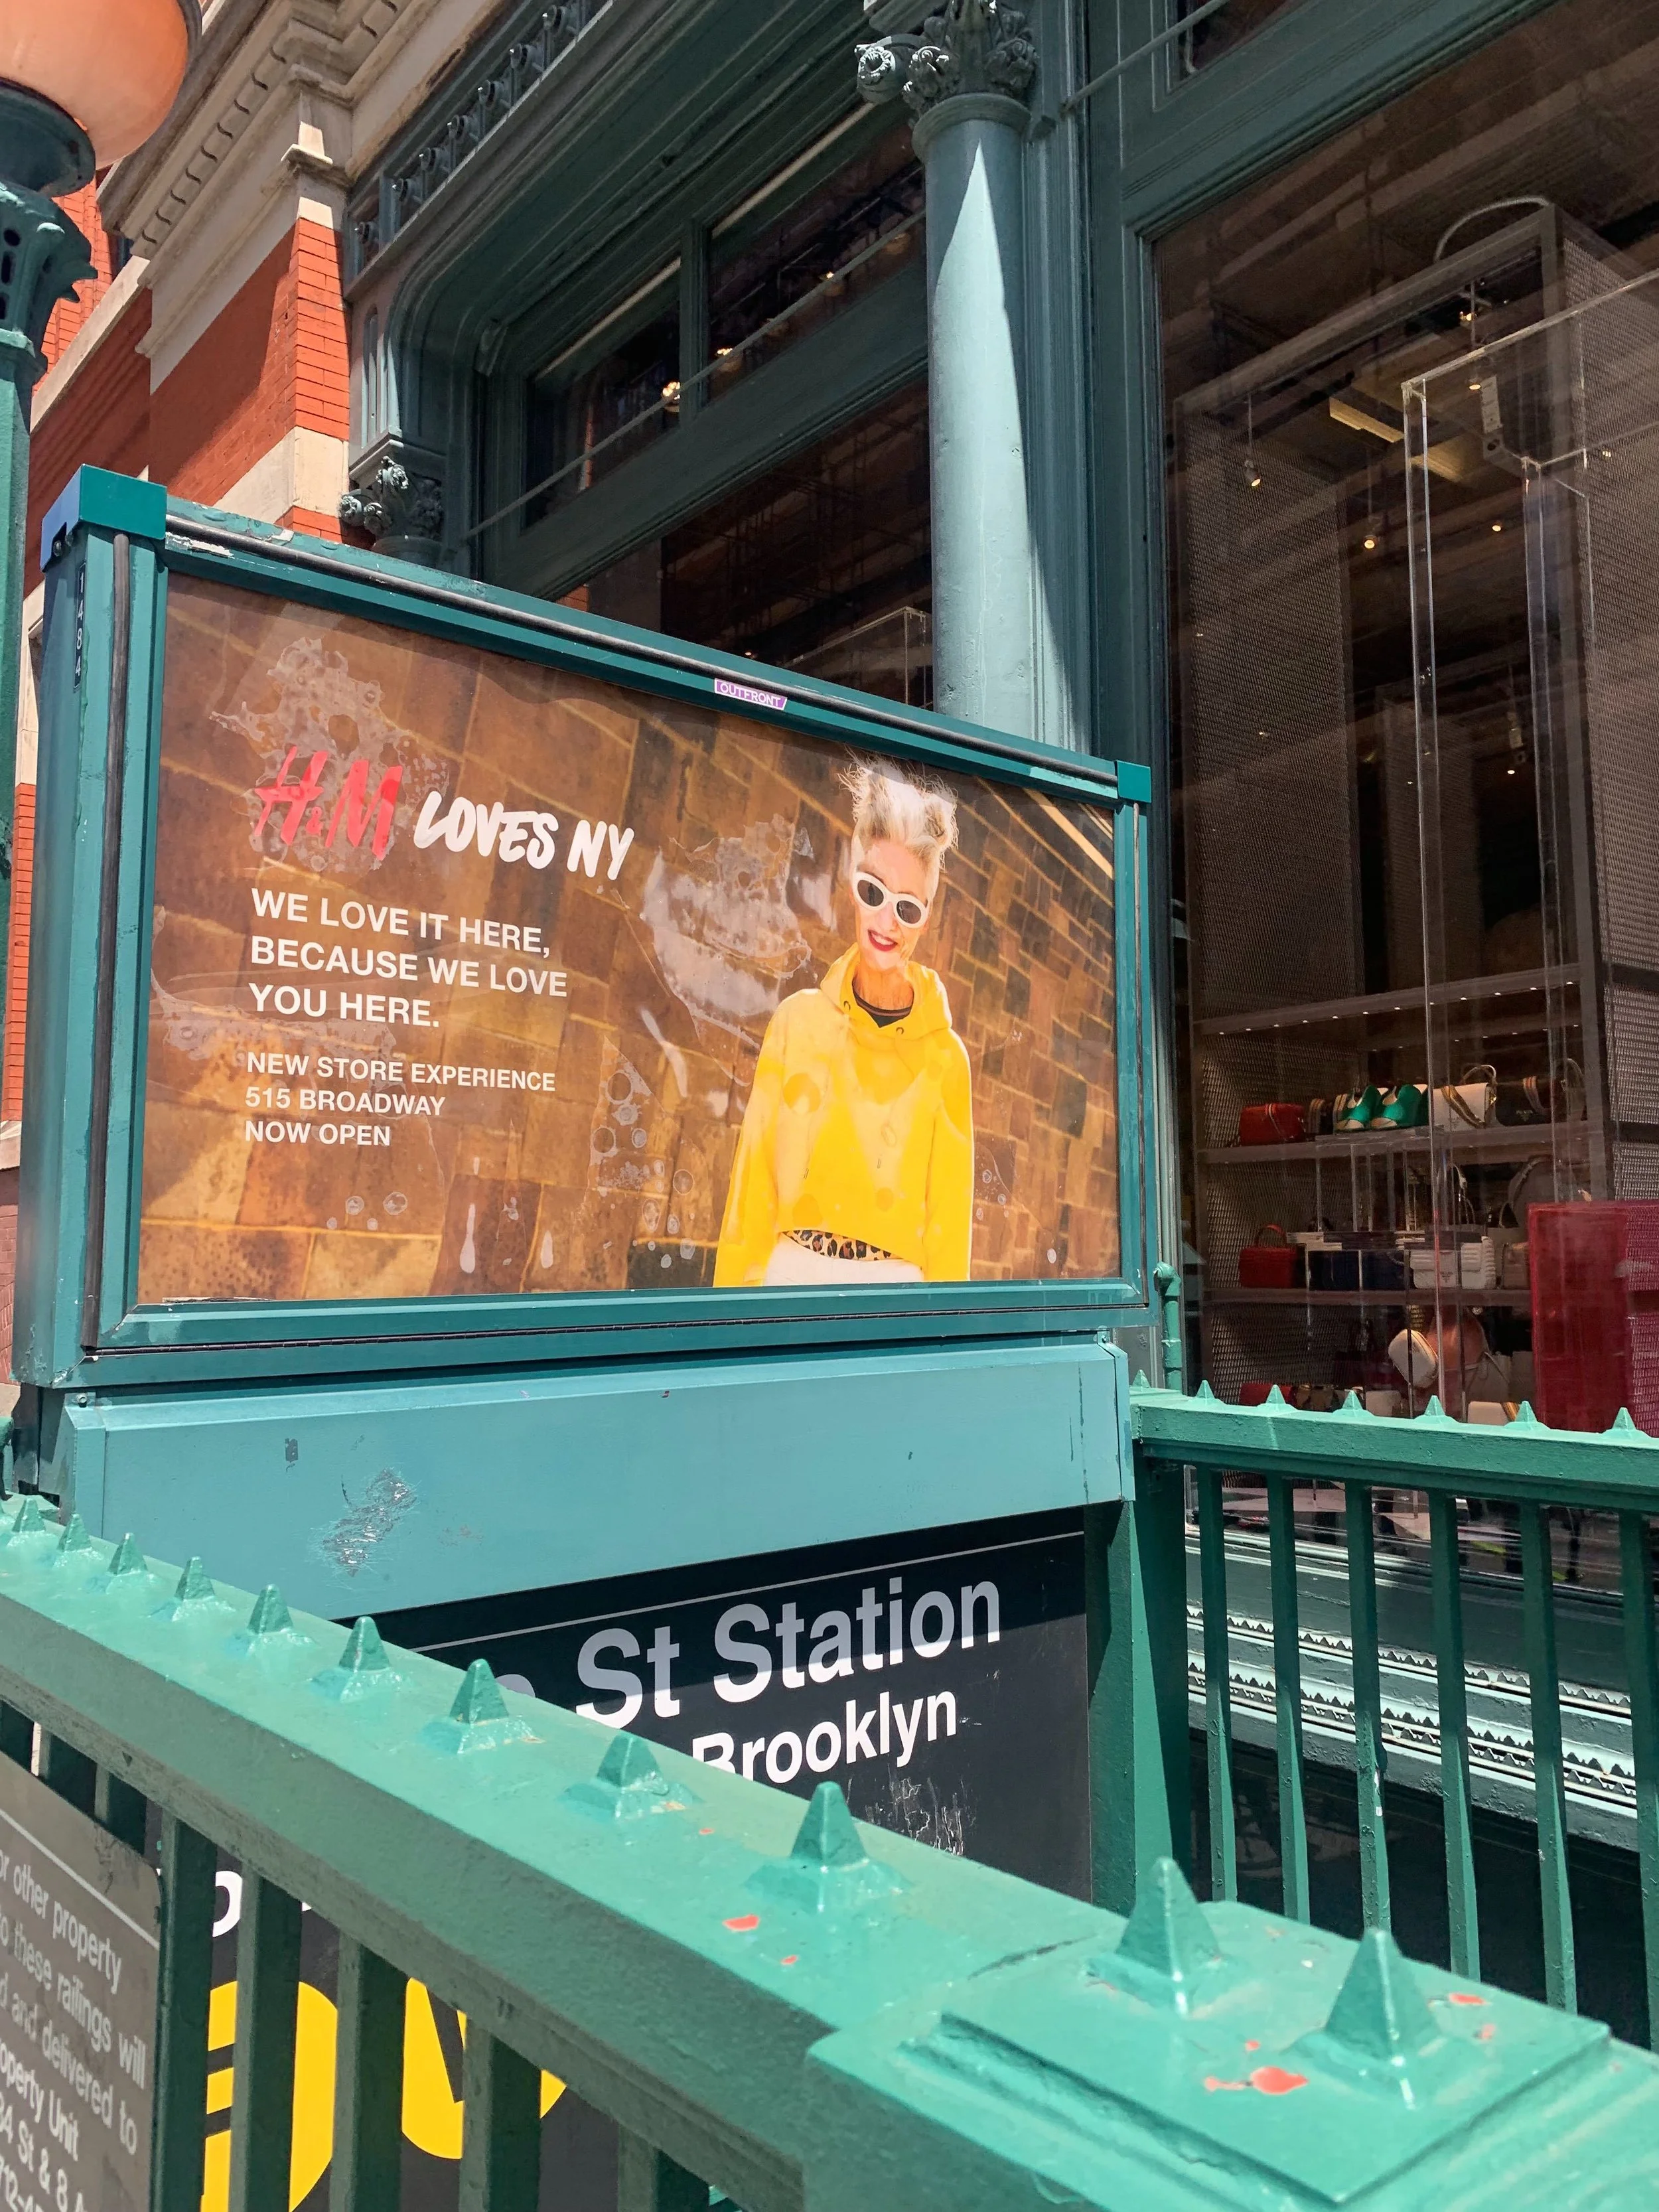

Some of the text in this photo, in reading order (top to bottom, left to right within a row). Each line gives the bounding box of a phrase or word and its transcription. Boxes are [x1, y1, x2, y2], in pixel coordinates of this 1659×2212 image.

[75, 572, 84, 676] 1484
[720, 683, 780, 707] OUTFRONT
[255, 745, 635, 881] H&M LOVES NY
[252, 887, 551, 958] WE LOVE IT HERE,
[251, 936, 567, 997] BECAUSE WE LOVE
[248, 983, 440, 1028] YOU HERE.
[245, 1086, 445, 1116] 515 BROADWAY
[247, 1052, 556, 1092] NEW STORE EXPERIENCE
[245, 1121, 390, 1147] NOW OPEN
[576, 1576, 1001, 1729] St Station
[692, 1690, 957, 1784] Brooklyn
[13, 1864, 49, 1919] other
[52, 1900, 121, 1994] property
[14, 1921, 52, 1991] these
[57, 1972, 111, 2053] railings
[118, 2031, 146, 2090] will
[11, 1992, 38, 2043] and
[42, 2019, 114, 2129] delivered
[119, 2099, 138, 2156] to
[17, 2119, 35, 2174] St
[48, 2089, 79, 2162] Unit
